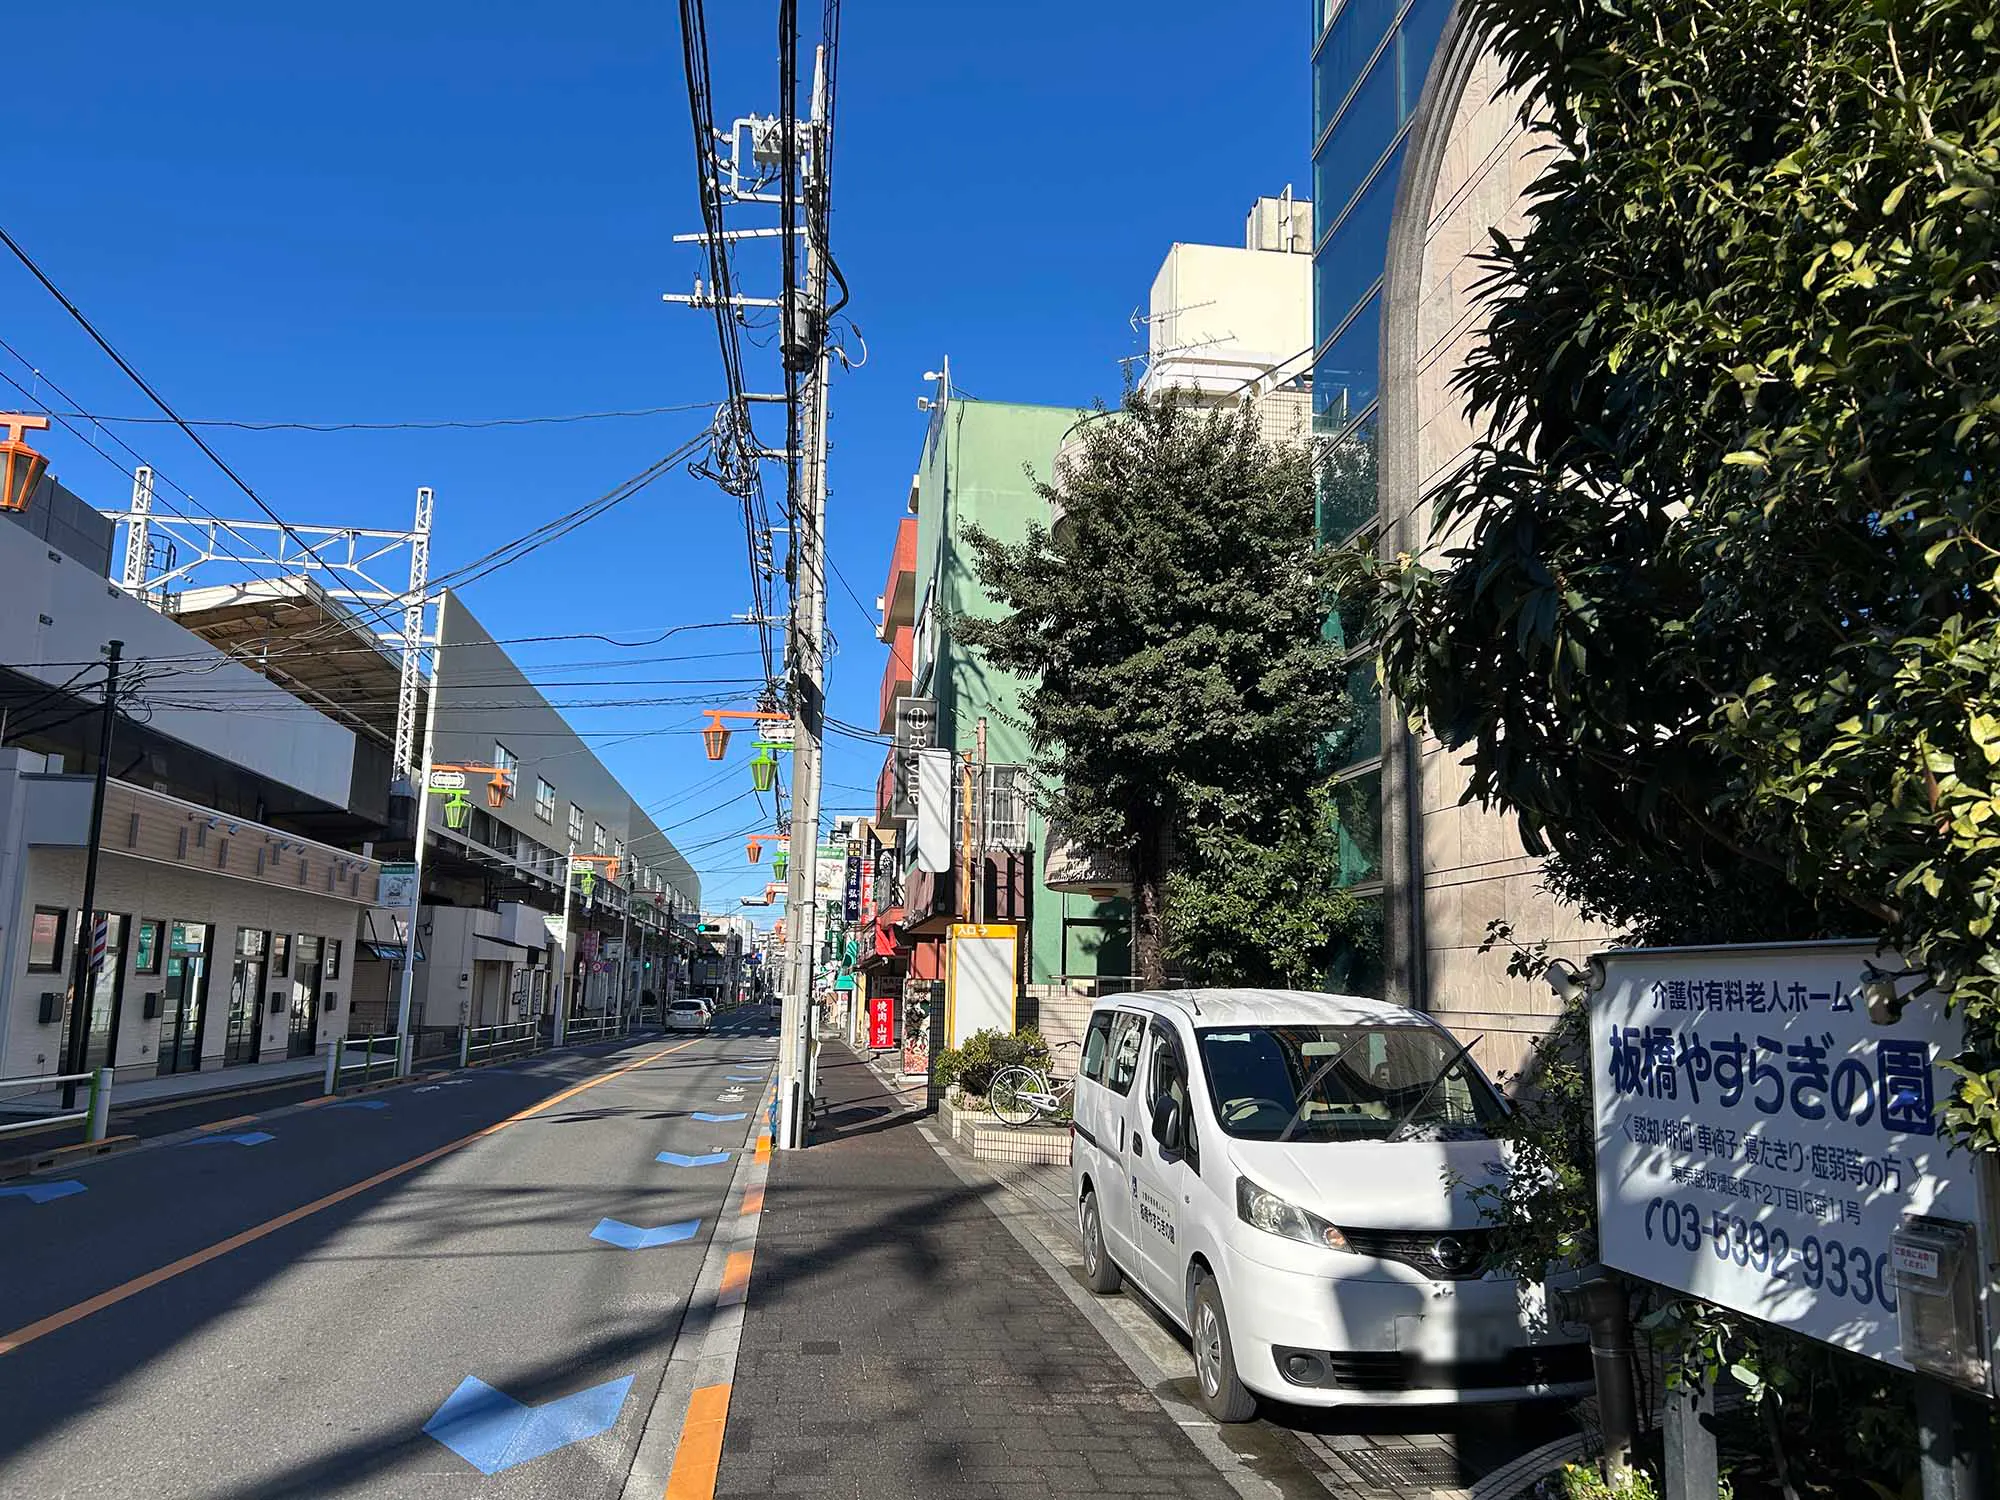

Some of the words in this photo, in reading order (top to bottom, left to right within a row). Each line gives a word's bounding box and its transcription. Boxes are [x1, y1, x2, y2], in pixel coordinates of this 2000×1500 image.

[958, 926, 976, 935] 入口
[1650, 980, 1855, 1014] 介護付有料老人ホーム
[876, 1000, 888, 1045] 焼肉山河
[1608, 1023, 1935, 1136] 板橋やすらぎの園
[1671, 1164, 1862, 1226] 東京都板橋区坂下2丁目15番11号
